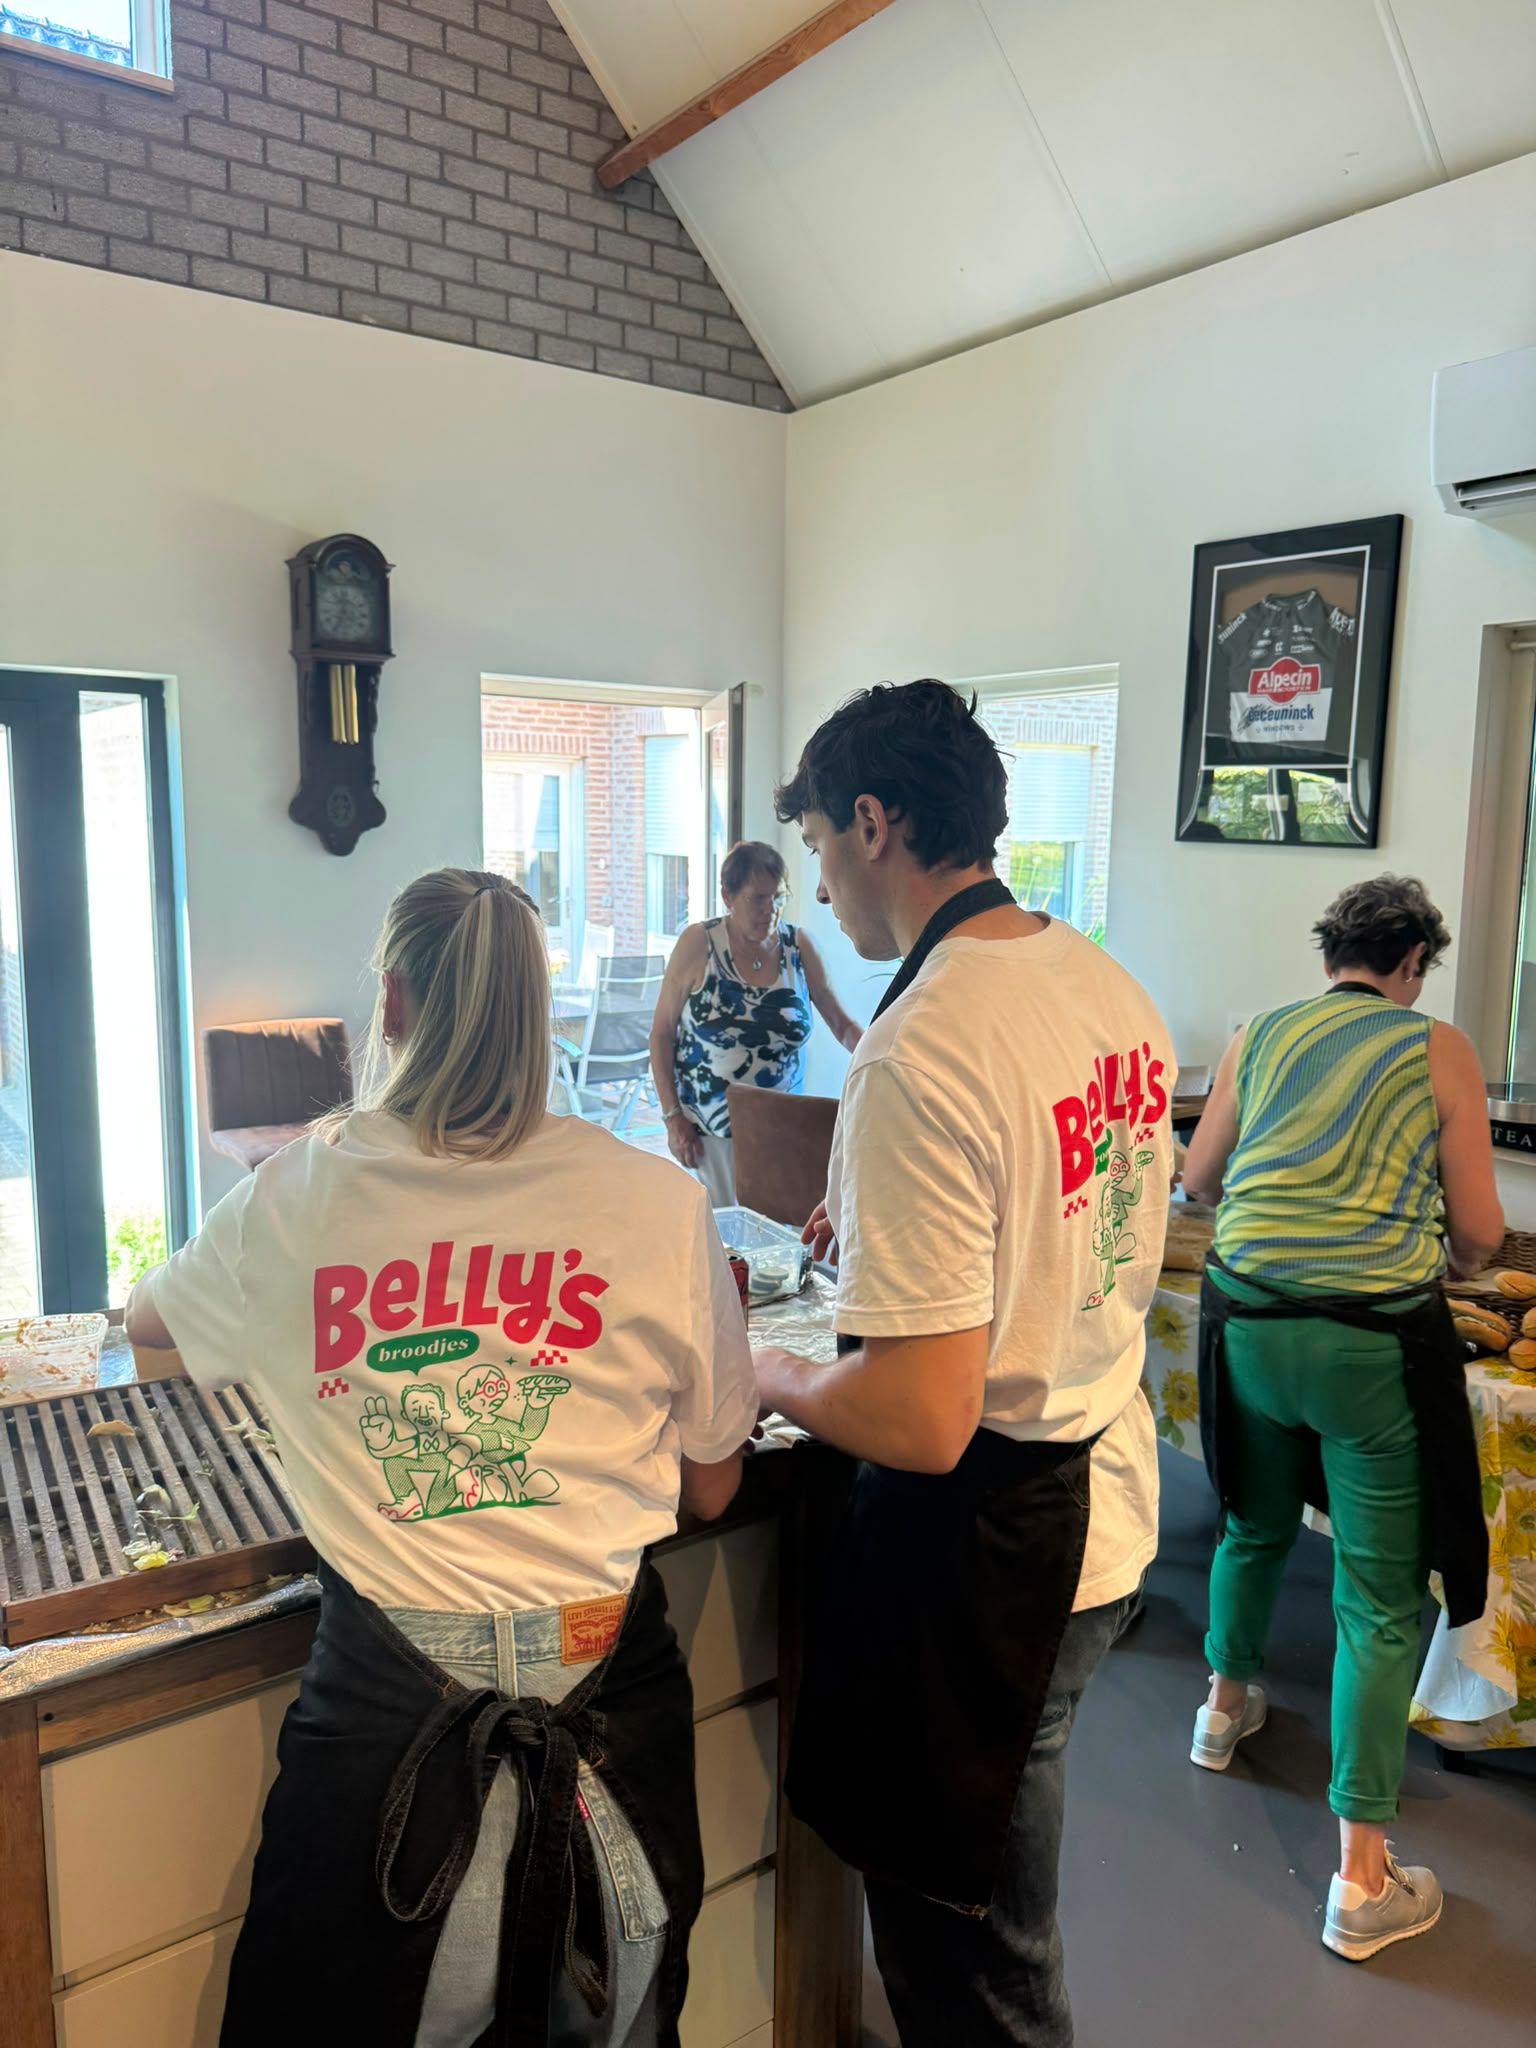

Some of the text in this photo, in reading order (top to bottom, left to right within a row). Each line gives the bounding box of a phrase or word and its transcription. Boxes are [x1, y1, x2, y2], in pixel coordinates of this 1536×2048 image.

[1257, 669, 1312, 690] Alpecin
[1493, 1127, 1532, 1147] TEA
[378, 1336, 469, 1363] broodjes
